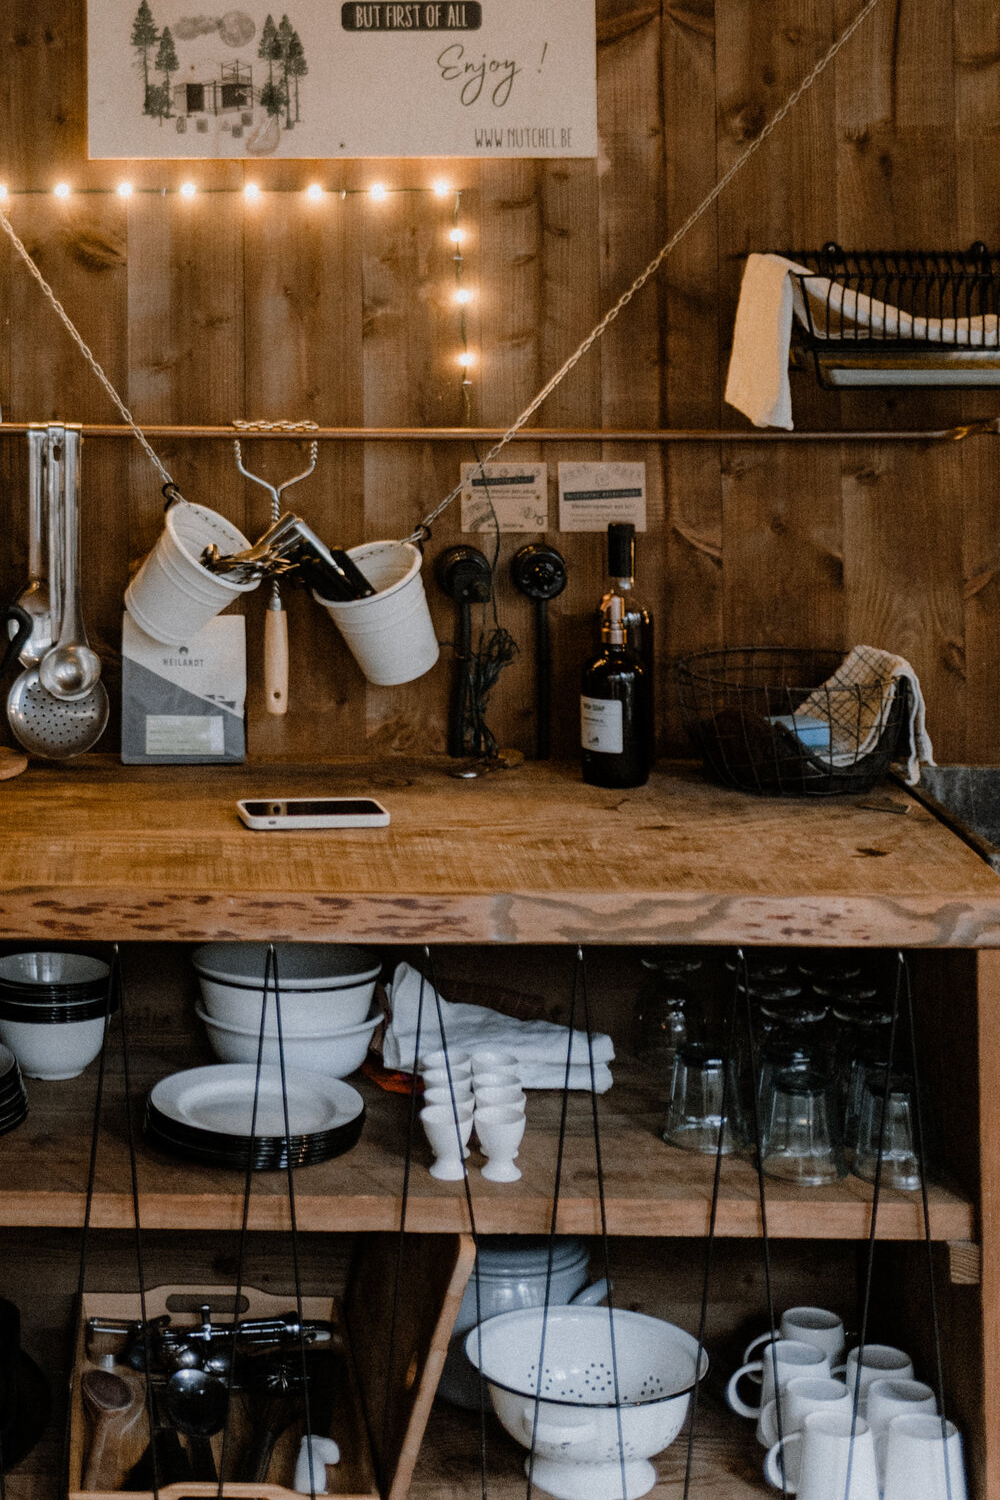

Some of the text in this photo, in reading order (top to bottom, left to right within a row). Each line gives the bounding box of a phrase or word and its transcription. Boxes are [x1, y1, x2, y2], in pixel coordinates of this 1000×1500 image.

[356, 4, 468, 28] BUT FIRST OF ALL
[437, 43, 522, 108] Enjoy
